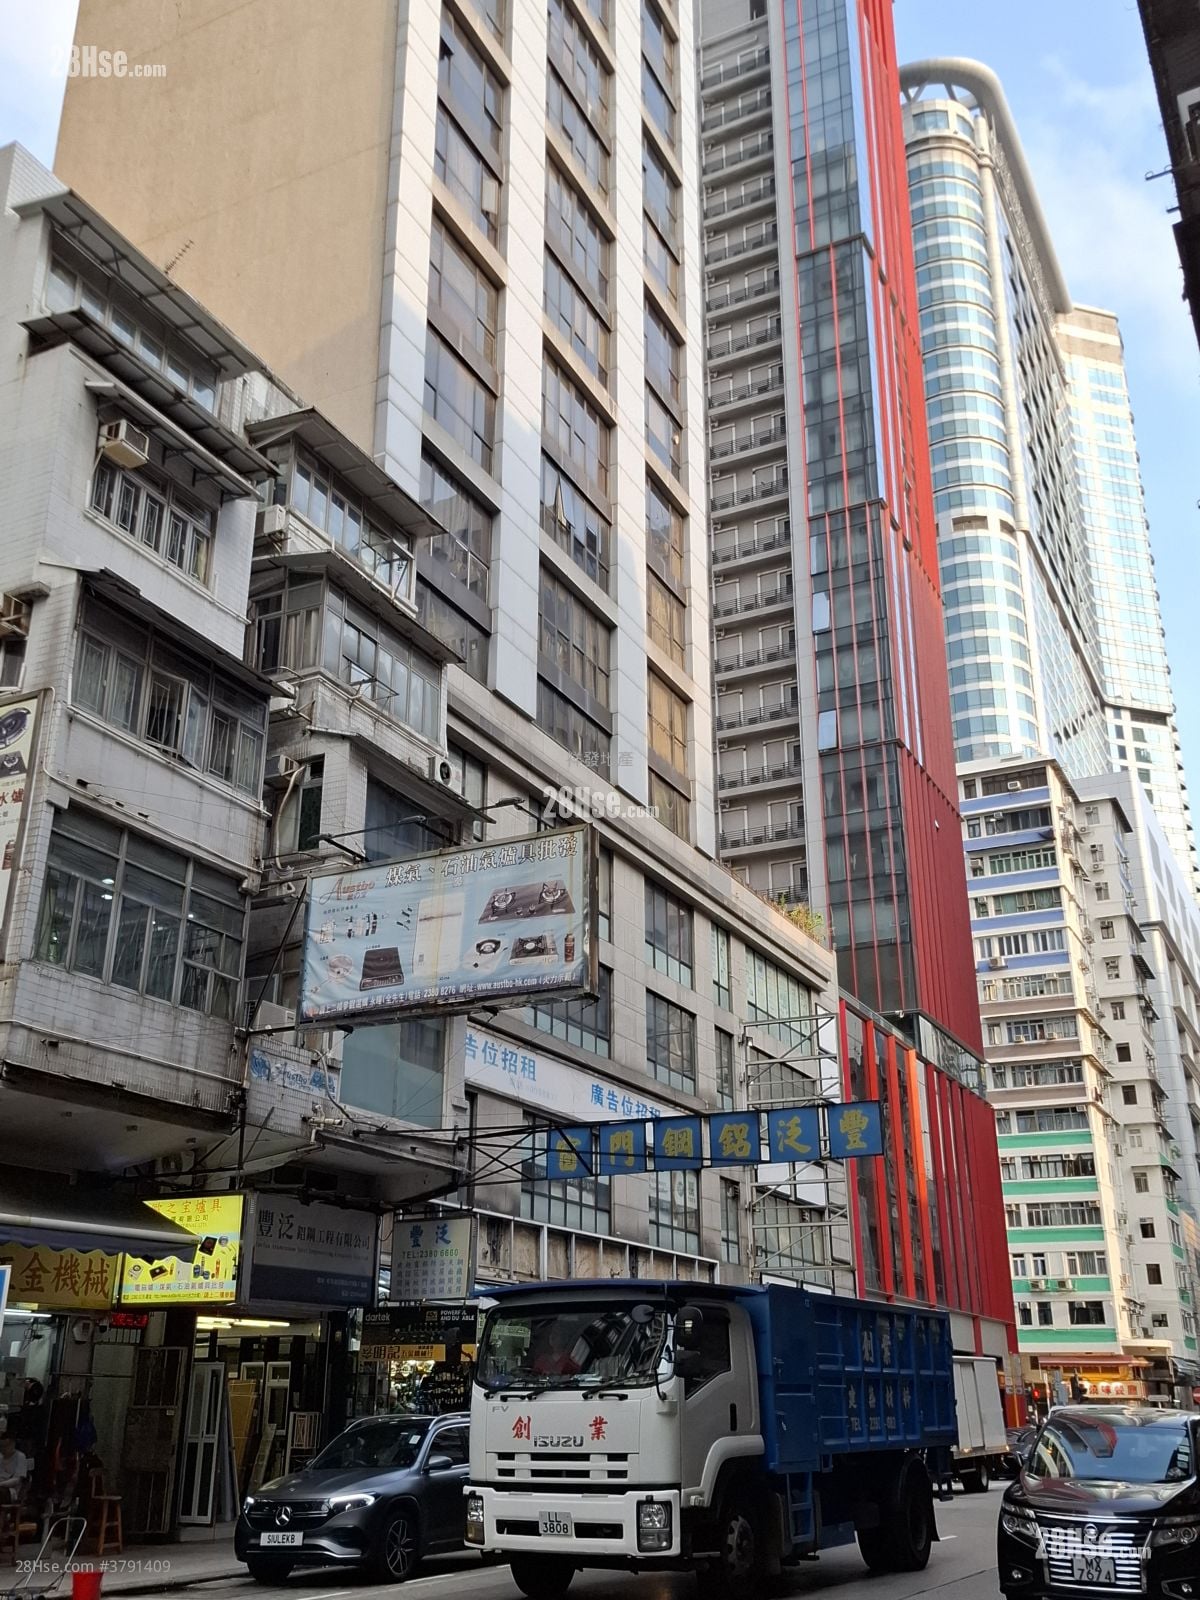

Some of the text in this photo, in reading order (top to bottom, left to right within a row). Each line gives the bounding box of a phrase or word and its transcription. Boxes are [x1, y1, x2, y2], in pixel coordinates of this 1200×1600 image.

[512, 1415, 608, 1440] 創 業
[534, 1435, 584, 1448] ISUZU
[547, 1511, 562, 1523] LL
[543, 1522, 569, 1534] 3808
